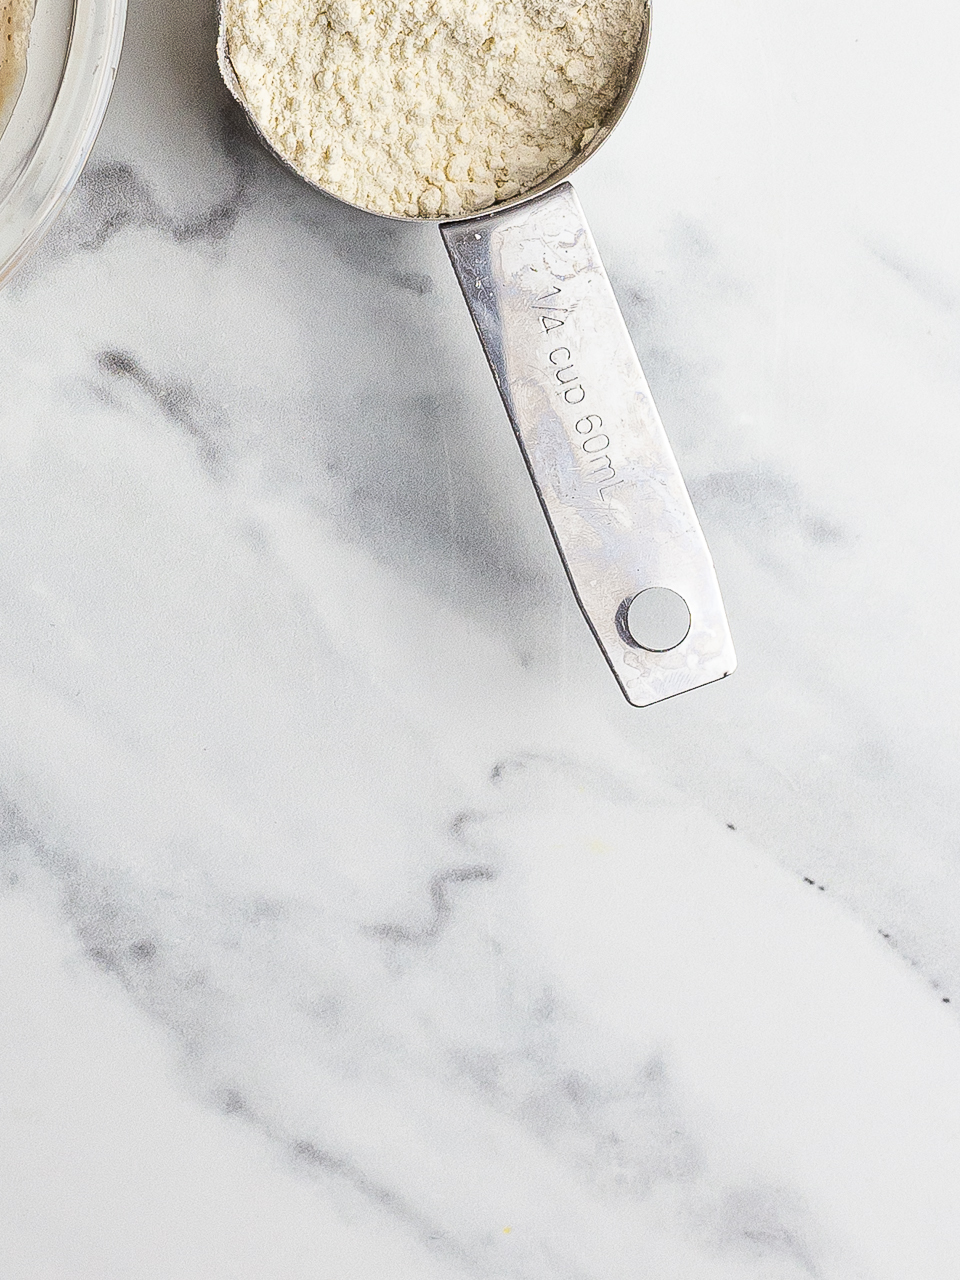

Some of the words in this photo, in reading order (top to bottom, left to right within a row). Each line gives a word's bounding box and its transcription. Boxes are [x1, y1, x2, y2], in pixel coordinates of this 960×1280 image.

[531, 285, 568, 335] 1/4
[548, 346, 586, 404] cup
[575, 414, 624, 501] 60mL
